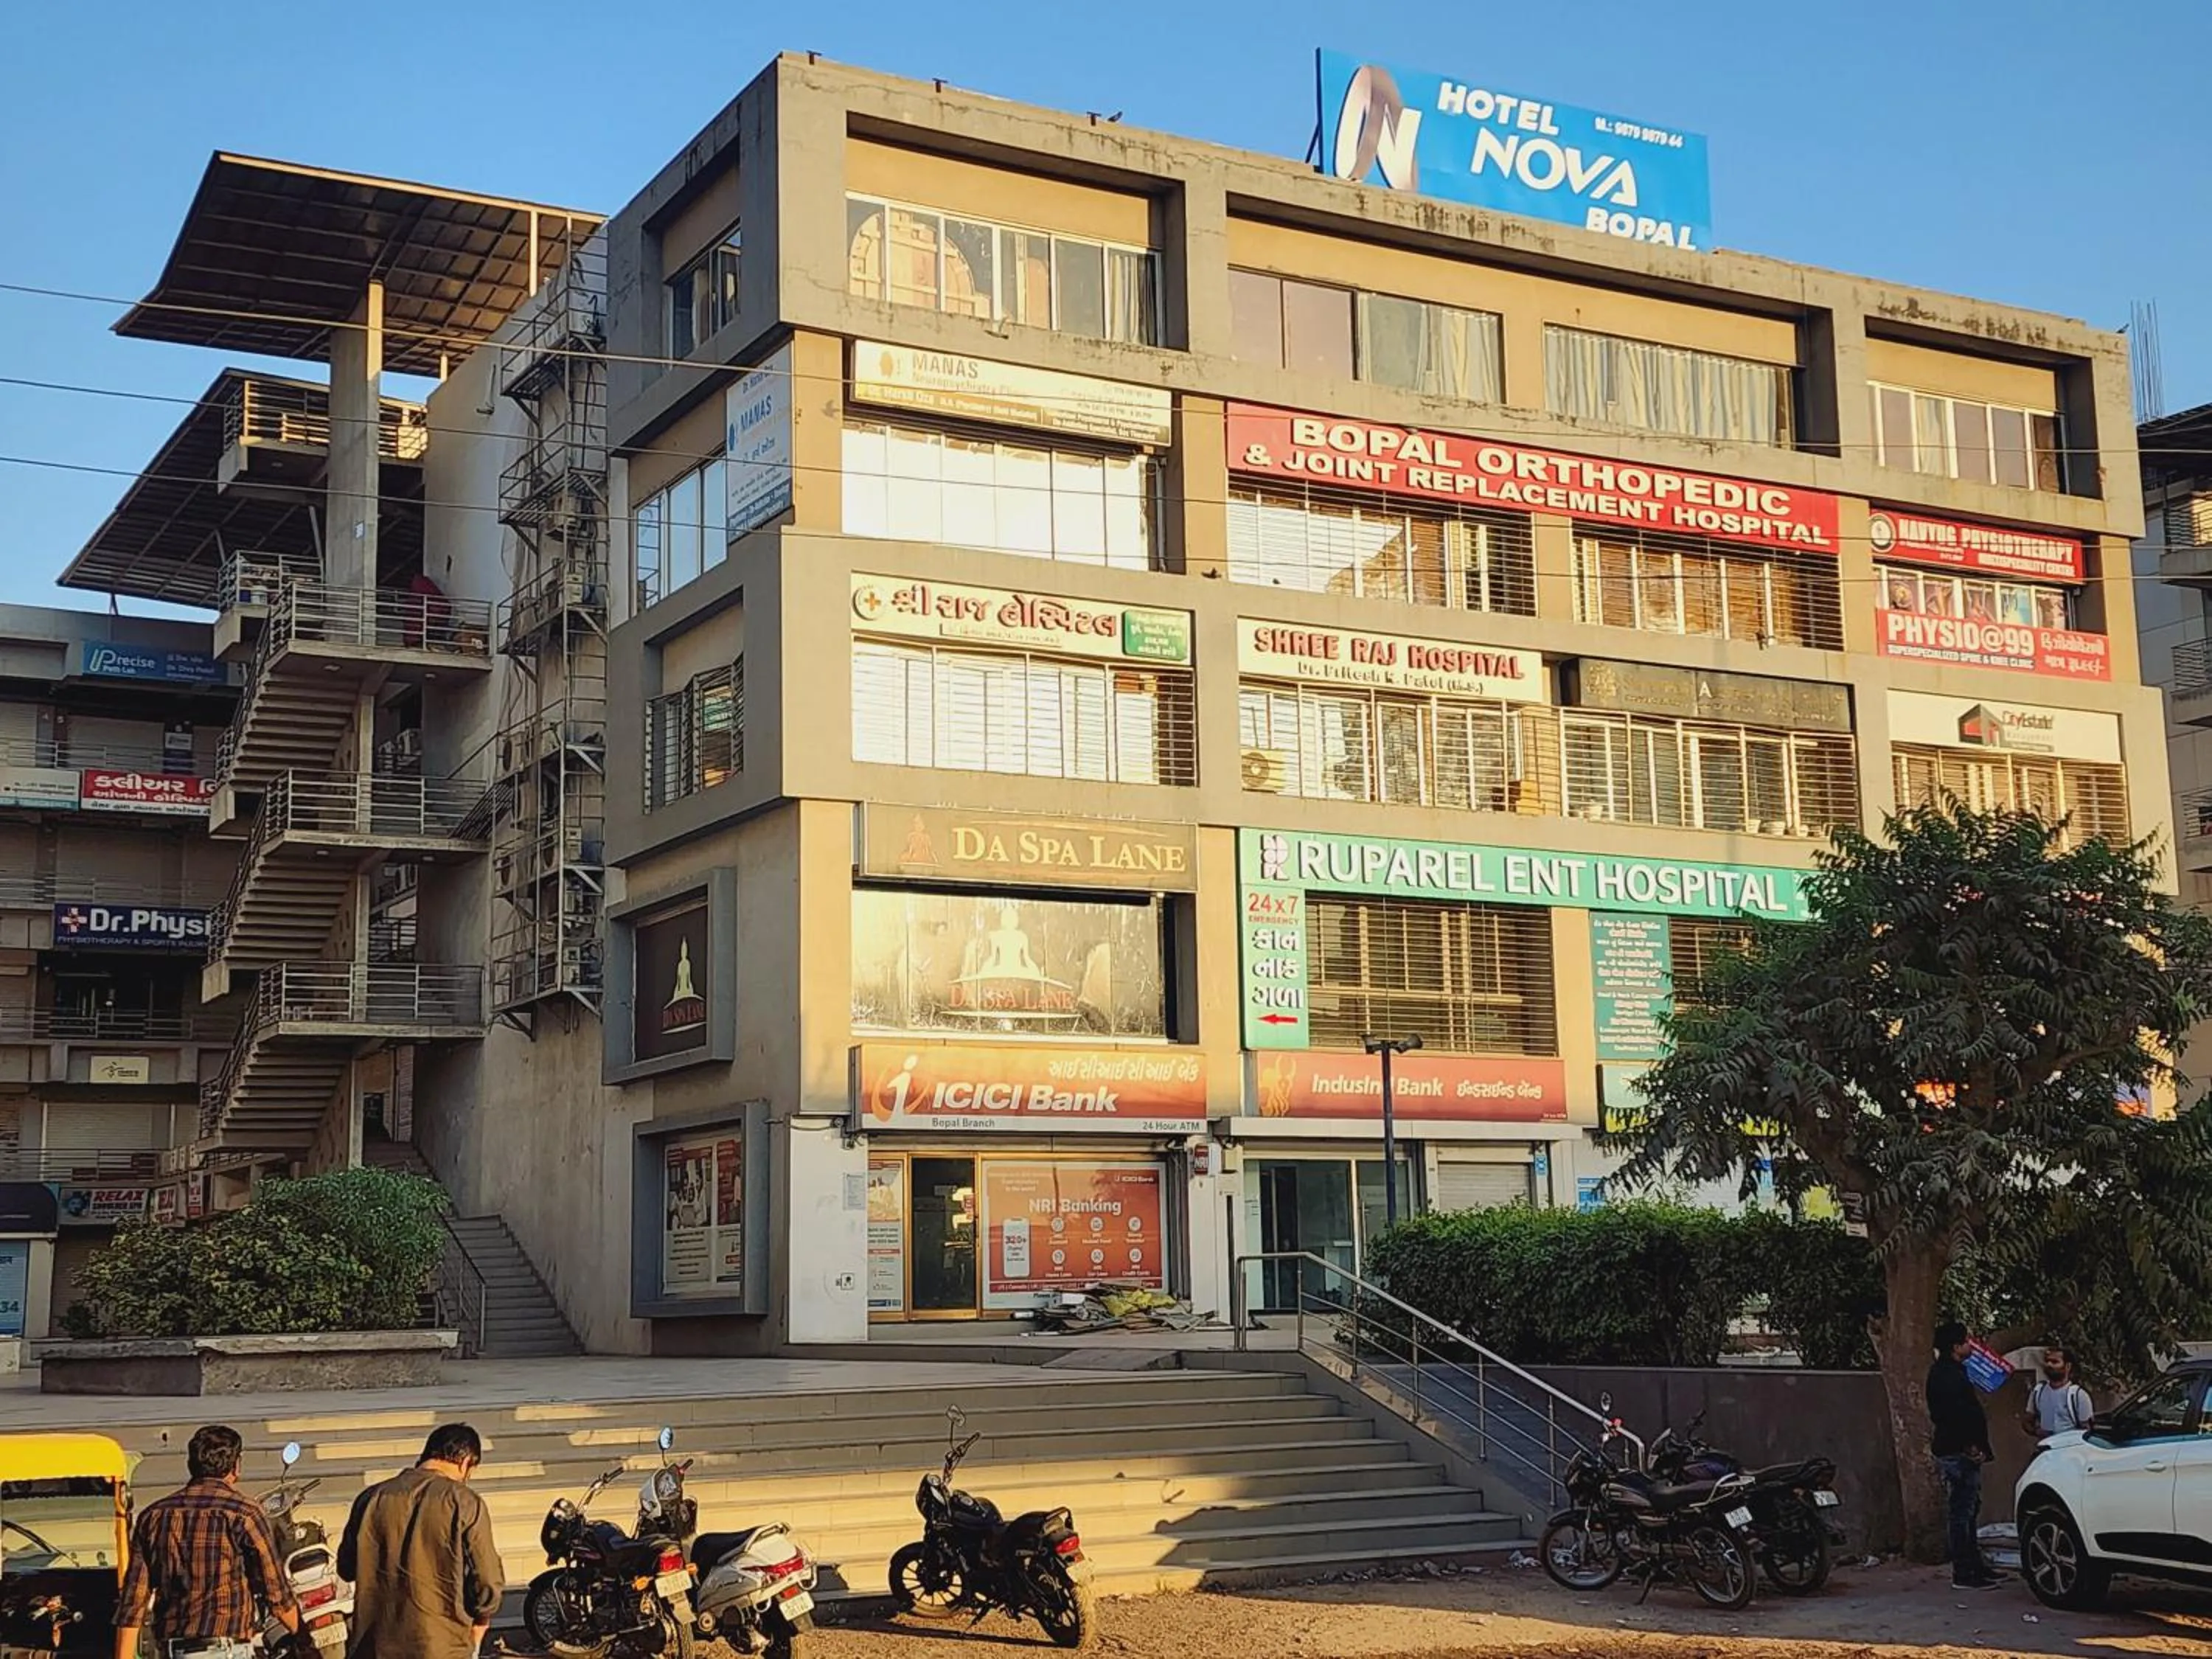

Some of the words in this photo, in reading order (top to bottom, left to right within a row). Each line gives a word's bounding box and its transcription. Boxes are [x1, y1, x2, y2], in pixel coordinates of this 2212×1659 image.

[1437, 81, 1559, 136] HOTEL
[1470, 128, 1638, 207] NOVA
[1586, 206, 1697, 251] BOPAL
[912, 353, 979, 378] MANAS
[1290, 418, 1462, 469] BOPAL
[1476, 446, 1792, 516] ORTHOPEDIC
[1244, 444, 1273, 467] &
[1281, 450, 1398, 484] JOINT
[1408, 466, 1665, 522] REPLACEMENT
[1672, 506, 1831, 546] HOSPITAL
[935, 594, 992, 622] રાજ
[997, 594, 1118, 638] હોસ્પિટલ
[1887, 613, 2035, 656] PHYSIO@99
[1254, 627, 1340, 661] SHREE
[1351, 638, 1398, 666] RAJ
[1408, 644, 1525, 680] HOSPITAL
[1298, 661, 1321, 676] Dr.
[953, 827, 1009, 864] DA
[1019, 831, 1082, 868] SPA
[1089, 835, 1187, 873] LANE
[1298, 840, 1495, 892] RUPAREL
[1505, 855, 1587, 898] ENT
[1595, 861, 1789, 912] HOSPITAL
[89, 908, 212, 939] Dr.Physi
[932, 1083, 1024, 1110] ICICI
[1028, 1087, 1119, 1112] Bank
[1312, 1074, 1393, 1095] IndusIn
[1397, 1077, 1443, 1097] Bank
[932, 1118, 960, 1129] Bopal
[962, 1119, 995, 1128] Branch
[1143, 1121, 1153, 1130] 24
[1155, 1122, 1177, 1130] Hour
[1180, 1121, 1200, 1130] ATM
[94, 1191, 145, 1203] RELAX
[1029, 1197, 1056, 1214] NRI
[1060, 1198, 1122, 1216] Banking
